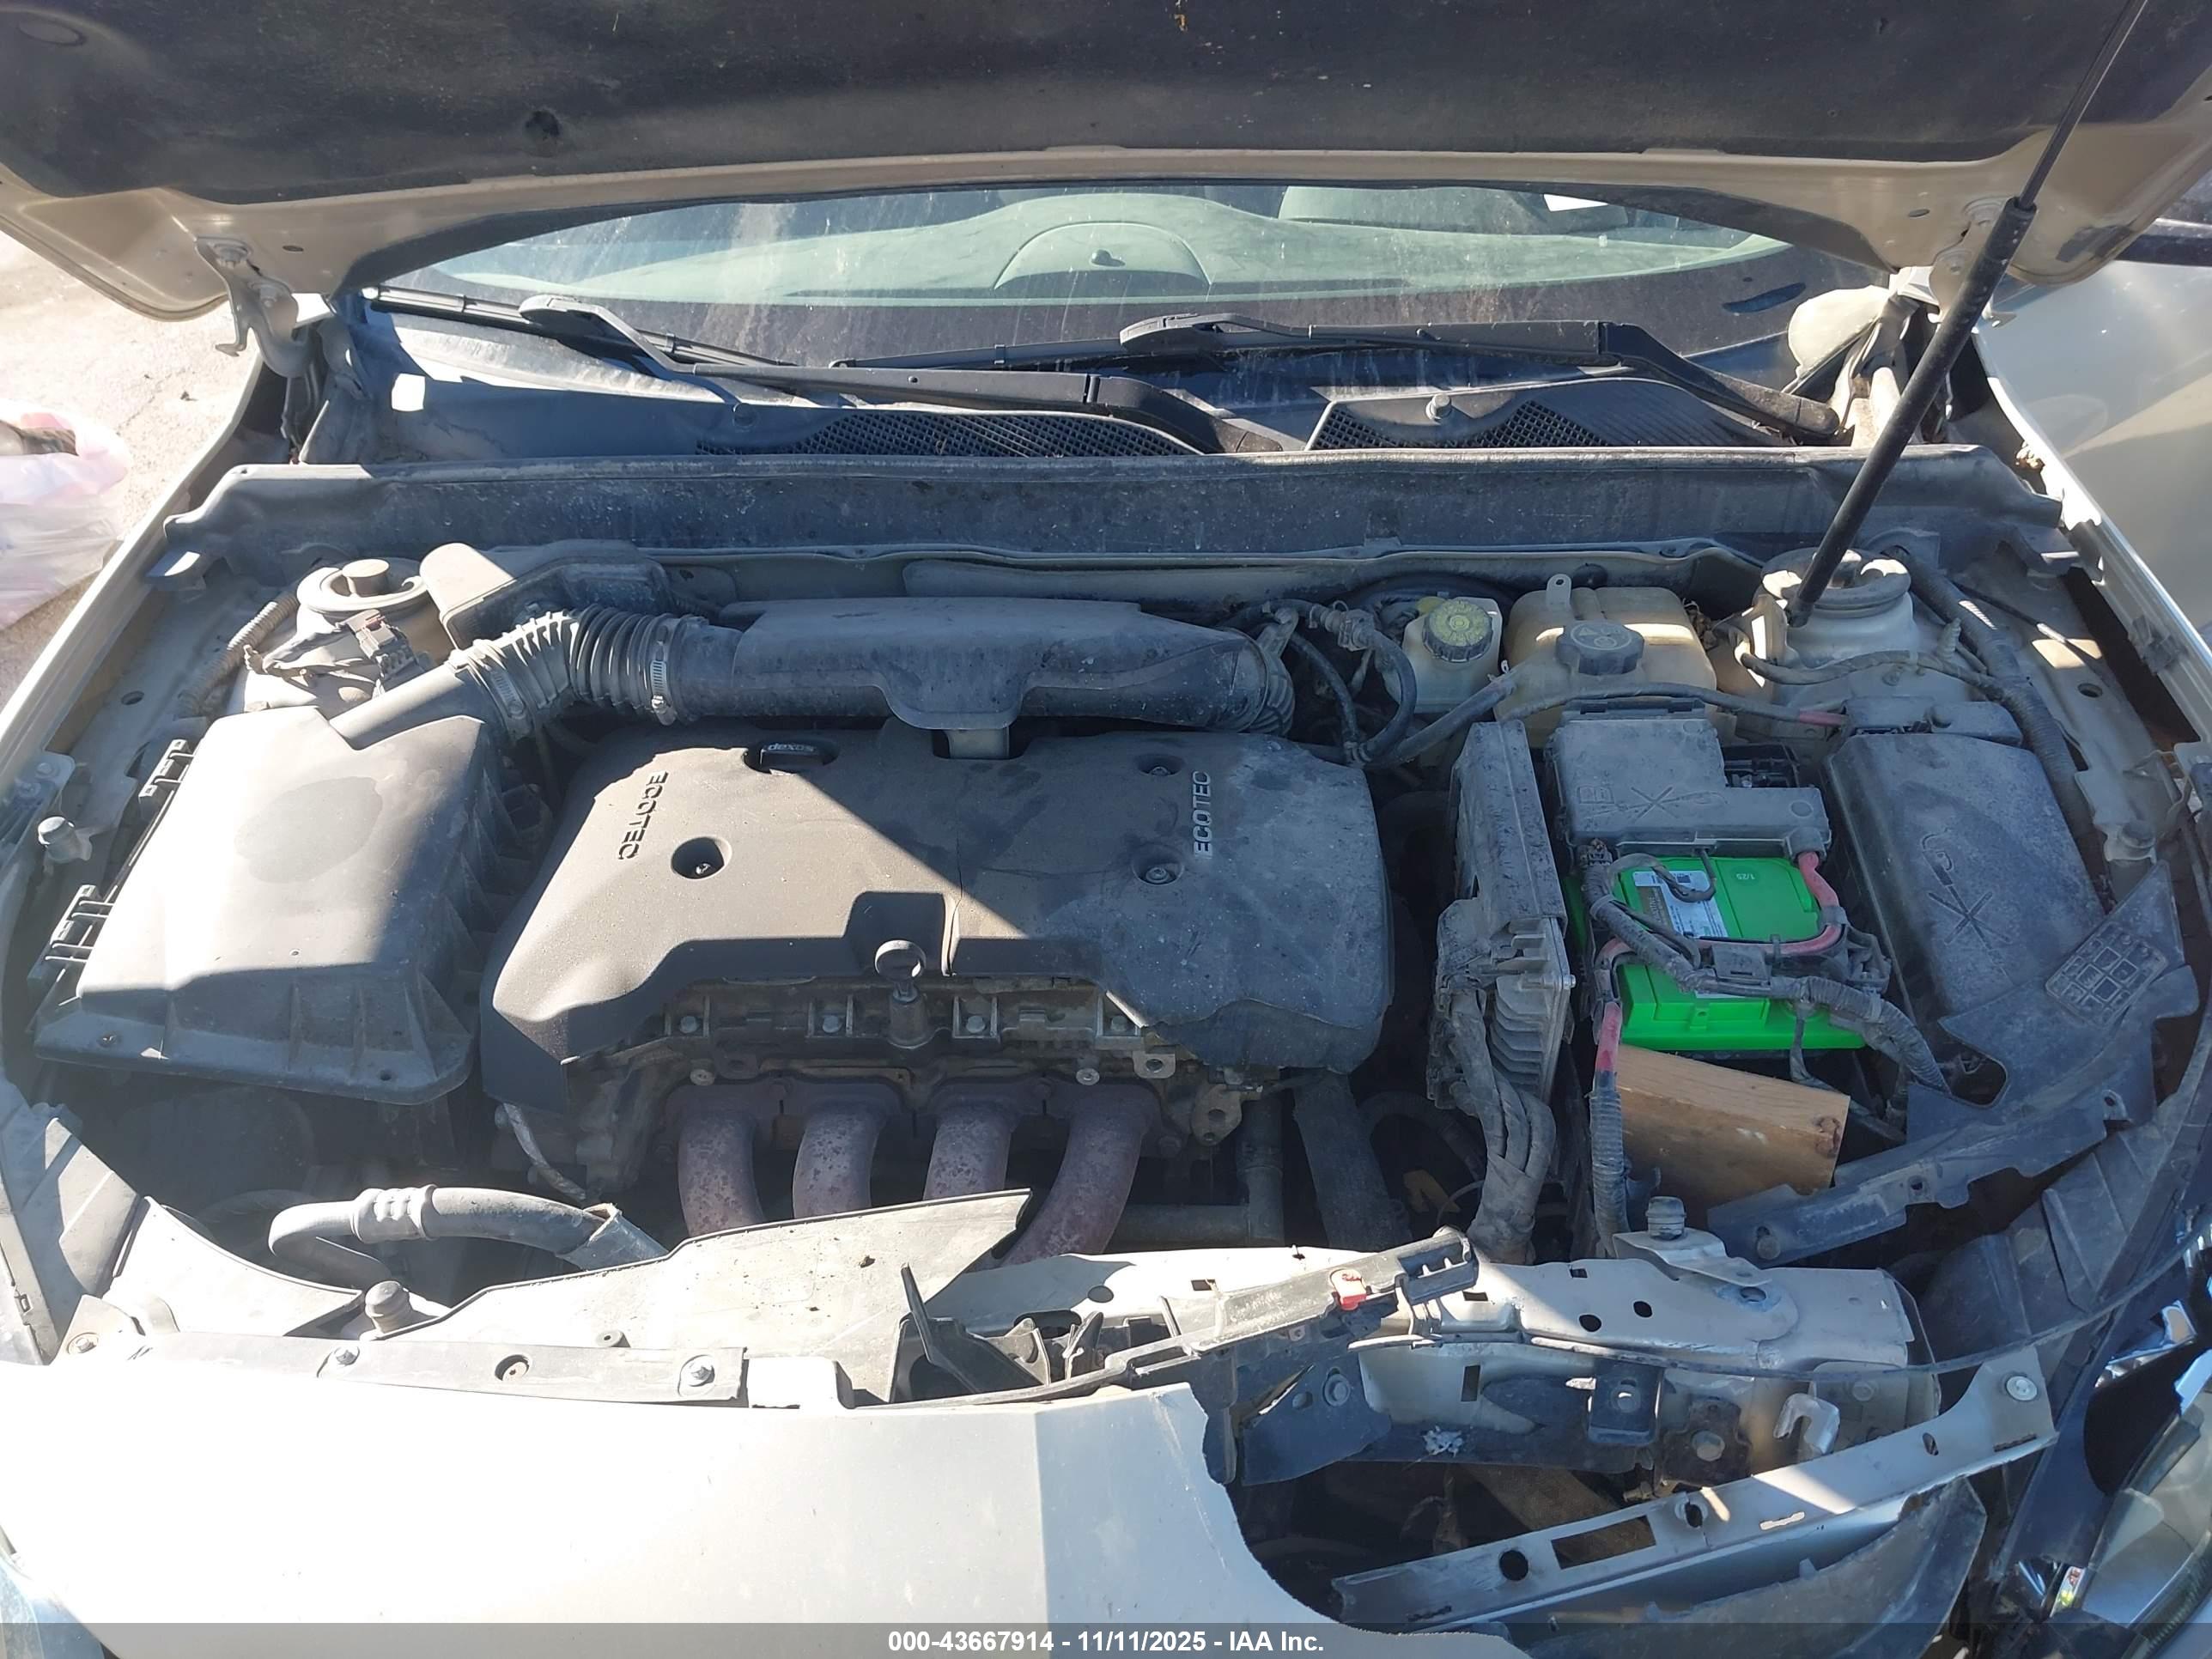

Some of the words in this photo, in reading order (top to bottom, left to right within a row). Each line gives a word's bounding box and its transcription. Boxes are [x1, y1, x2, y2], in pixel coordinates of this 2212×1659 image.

[767, 743, 816, 752] dexos
[618, 771, 669, 860] ECOTEC
[1192, 770, 1212, 859] ECOTEC
